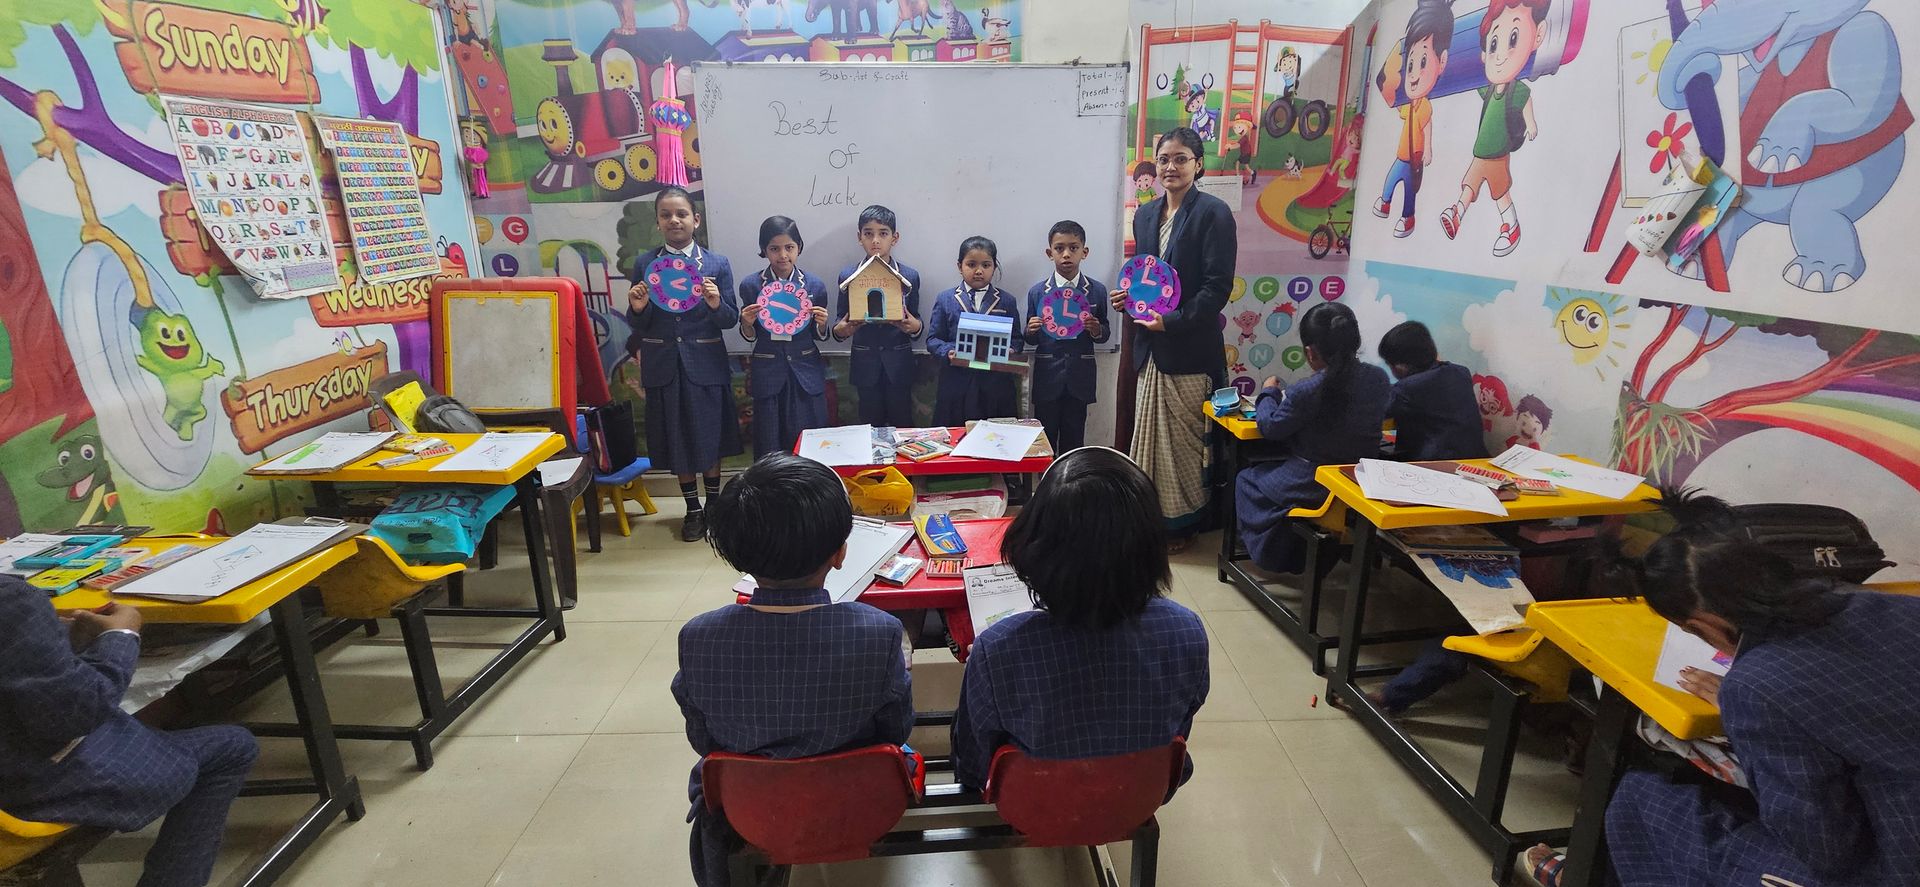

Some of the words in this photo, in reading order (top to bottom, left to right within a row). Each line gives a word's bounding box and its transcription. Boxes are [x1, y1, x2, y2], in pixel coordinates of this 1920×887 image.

[145, 9, 292, 84] Sunday
[183, 104, 229, 119] ENGLISH
[231, 109, 287, 123] ALPHABETS
[768, 101, 839, 137] Best
[177, 117, 191, 133] A
[209, 120, 223, 135] B
[242, 123, 255, 138] C
[271, 125, 284, 139] D
[181, 144, 197, 160] E
[216, 146, 228, 161] F
[250, 148, 263, 163] G
[279, 150, 290, 164] H
[191, 172, 202, 187] I
[227, 173, 238, 187] J
[255, 173, 269, 187] K
[283, 173, 295, 187] L
[807, 175, 859, 207] Luck
[201, 198, 217, 213] M
[231, 198, 246, 213] N
[263, 198, 275, 212] O
[289, 197, 300, 211] P
[212, 225, 226, 244] Q
[239, 223, 255, 238] R
[269, 222, 281, 235] S
[295, 220, 306, 234] T
[508, 221, 524, 236] G
[247, 248, 260, 262] V
[276, 245, 290, 259] W
[302, 243, 315, 257] X
[499, 258, 514, 272] L
[1259, 281, 1273, 295] C
[1294, 281, 1309, 295] D
[1325, 281, 1339, 295] E
[1254, 349, 1269, 362] N
[1287, 350, 1302, 363] O
[247, 361, 374, 430] Thursday
[1237, 381, 1250, 393] T
